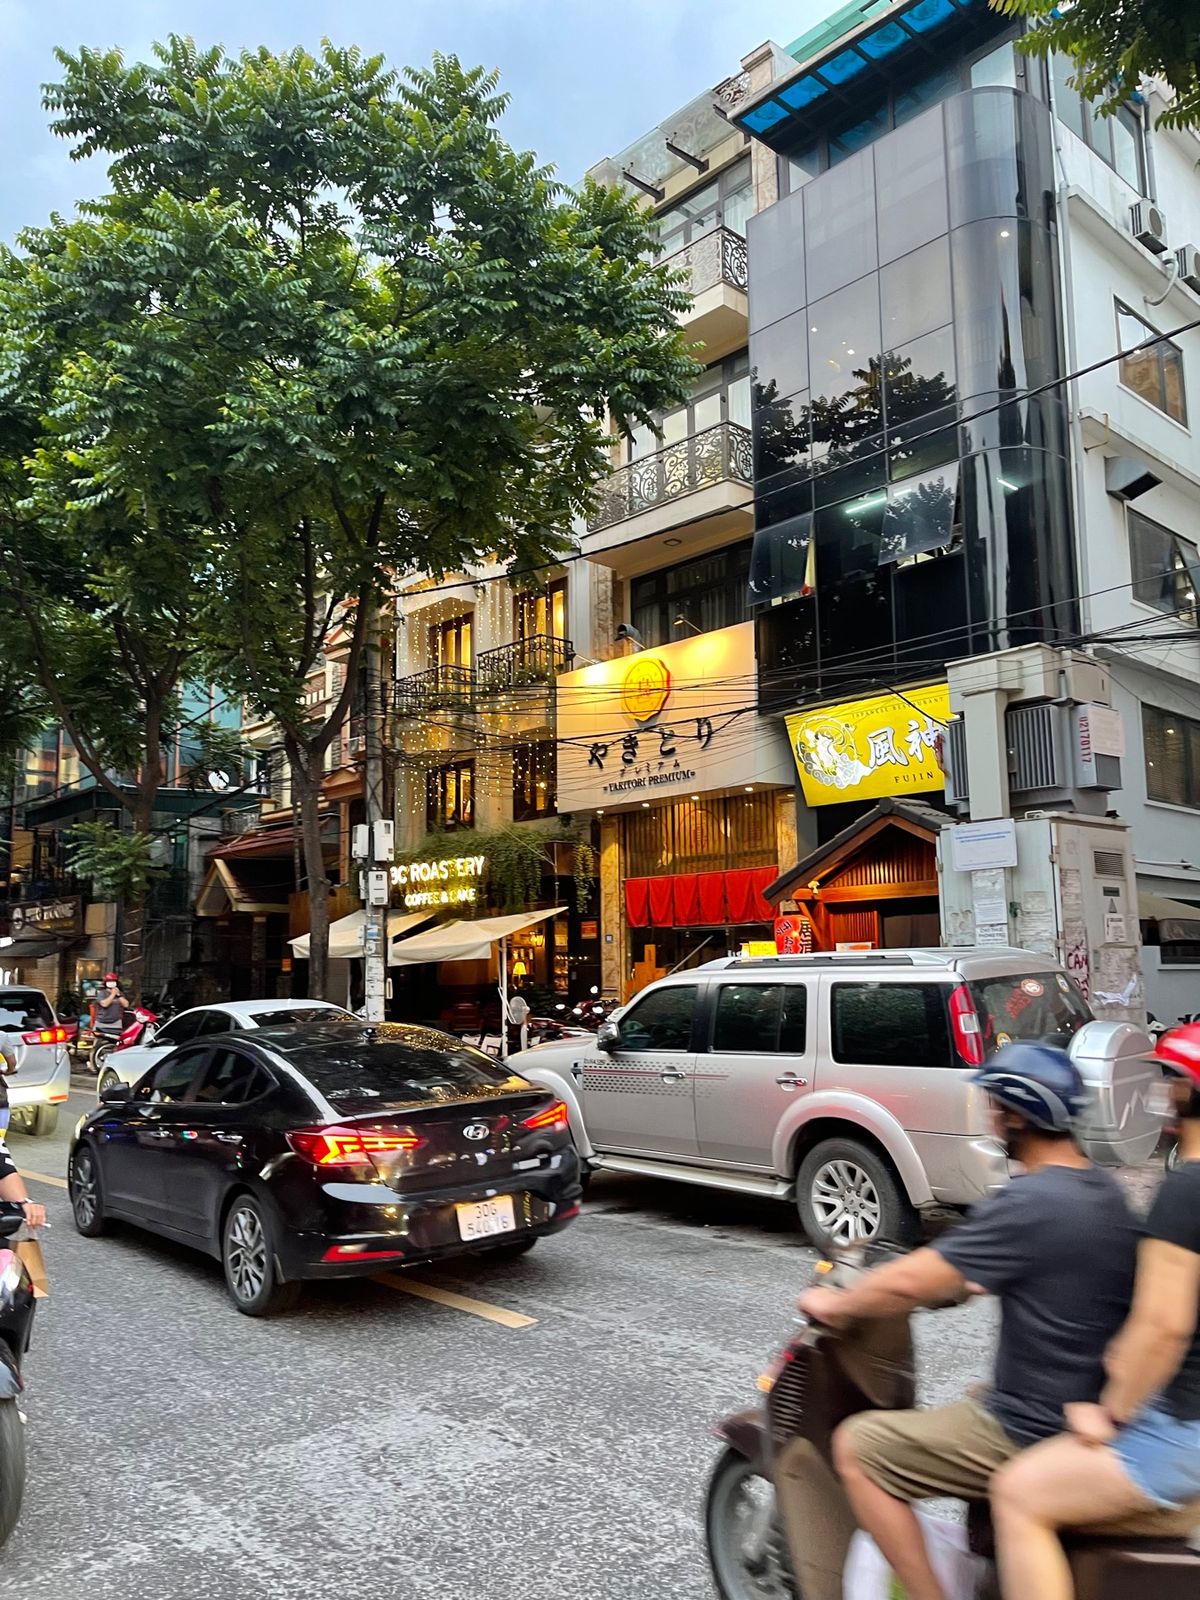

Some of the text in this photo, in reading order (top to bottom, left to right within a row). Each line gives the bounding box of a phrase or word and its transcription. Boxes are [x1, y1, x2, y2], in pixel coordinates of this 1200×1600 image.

[852, 705, 888, 718] JAPANESE
[588, 717, 713, 769] やきとり
[867, 716, 949, 769] 風神
[1078, 716, 1093, 763] 02170117
[609, 769, 690, 792] YAKITORI PREMIUM
[894, 771, 935, 784] FUJIN
[404, 891, 441, 907] COFFEE
